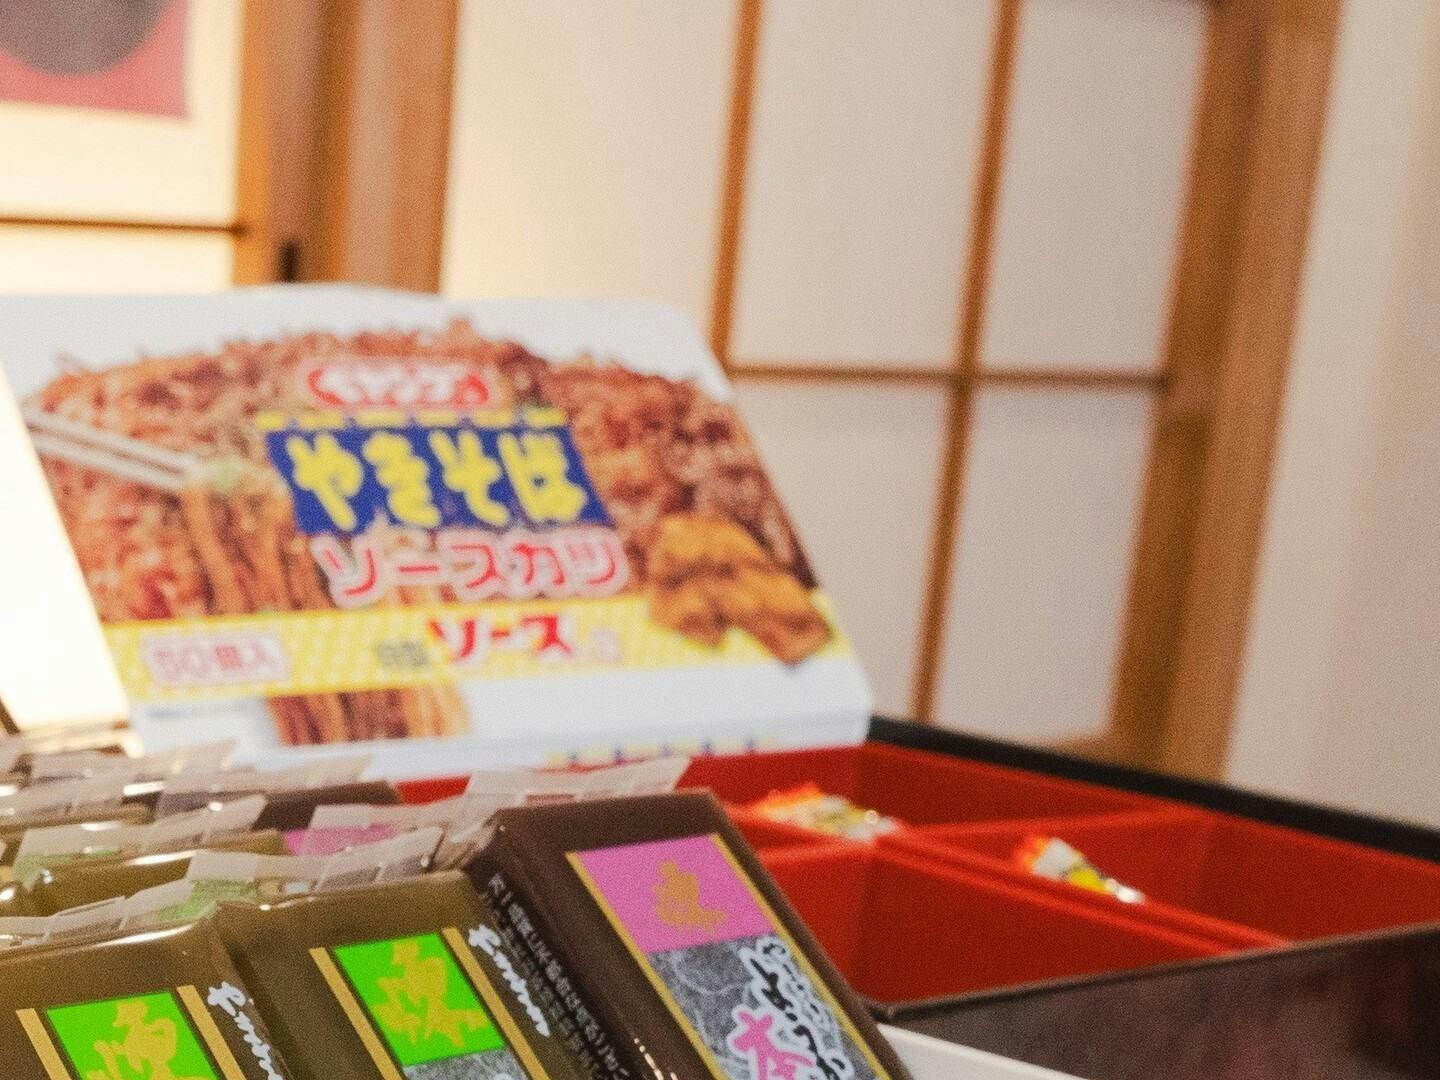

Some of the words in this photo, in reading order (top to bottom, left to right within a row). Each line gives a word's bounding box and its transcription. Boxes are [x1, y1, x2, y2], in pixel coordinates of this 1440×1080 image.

[285, 433, 587, 530] やきそば
[321, 538, 620, 600] ソースカツ
